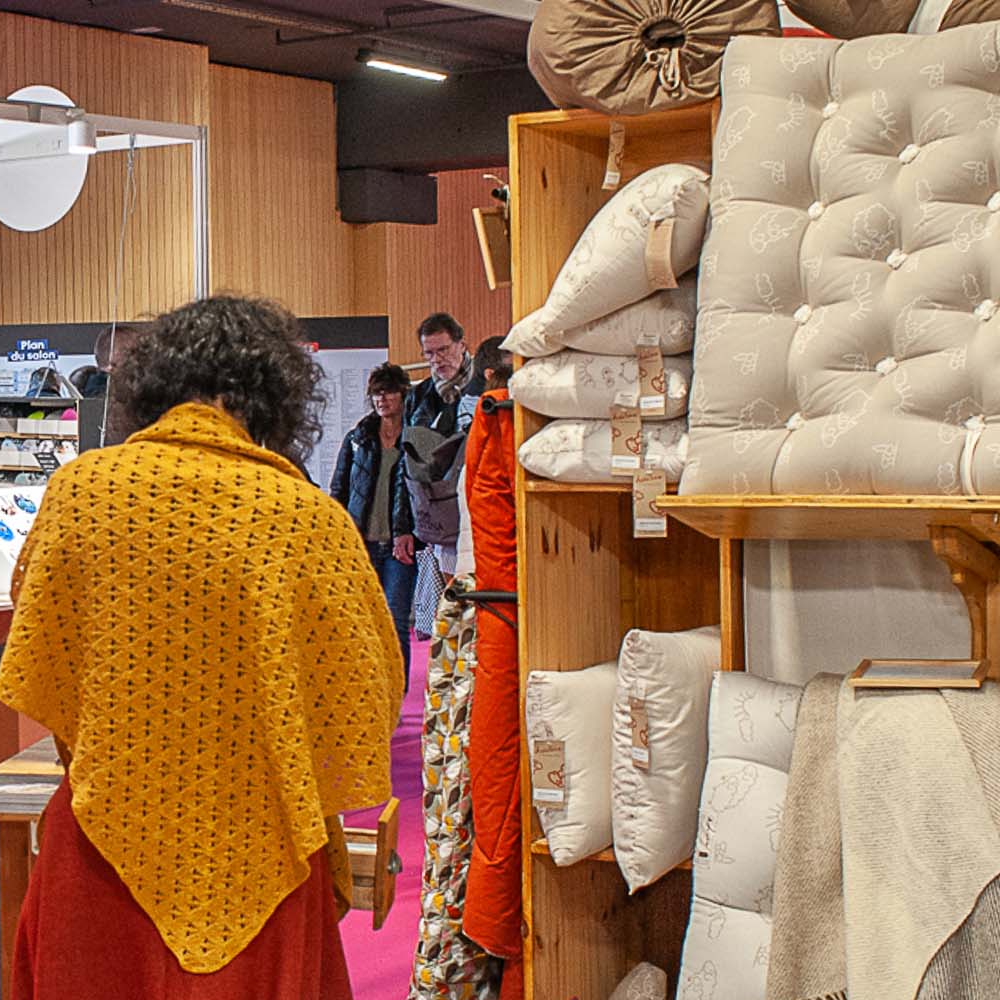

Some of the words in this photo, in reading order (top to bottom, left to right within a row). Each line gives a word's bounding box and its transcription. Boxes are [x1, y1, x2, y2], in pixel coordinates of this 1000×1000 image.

[20, 340, 46, 351] Plan
[10, 351, 25, 361] du
[27, 350, 56, 360] salon
